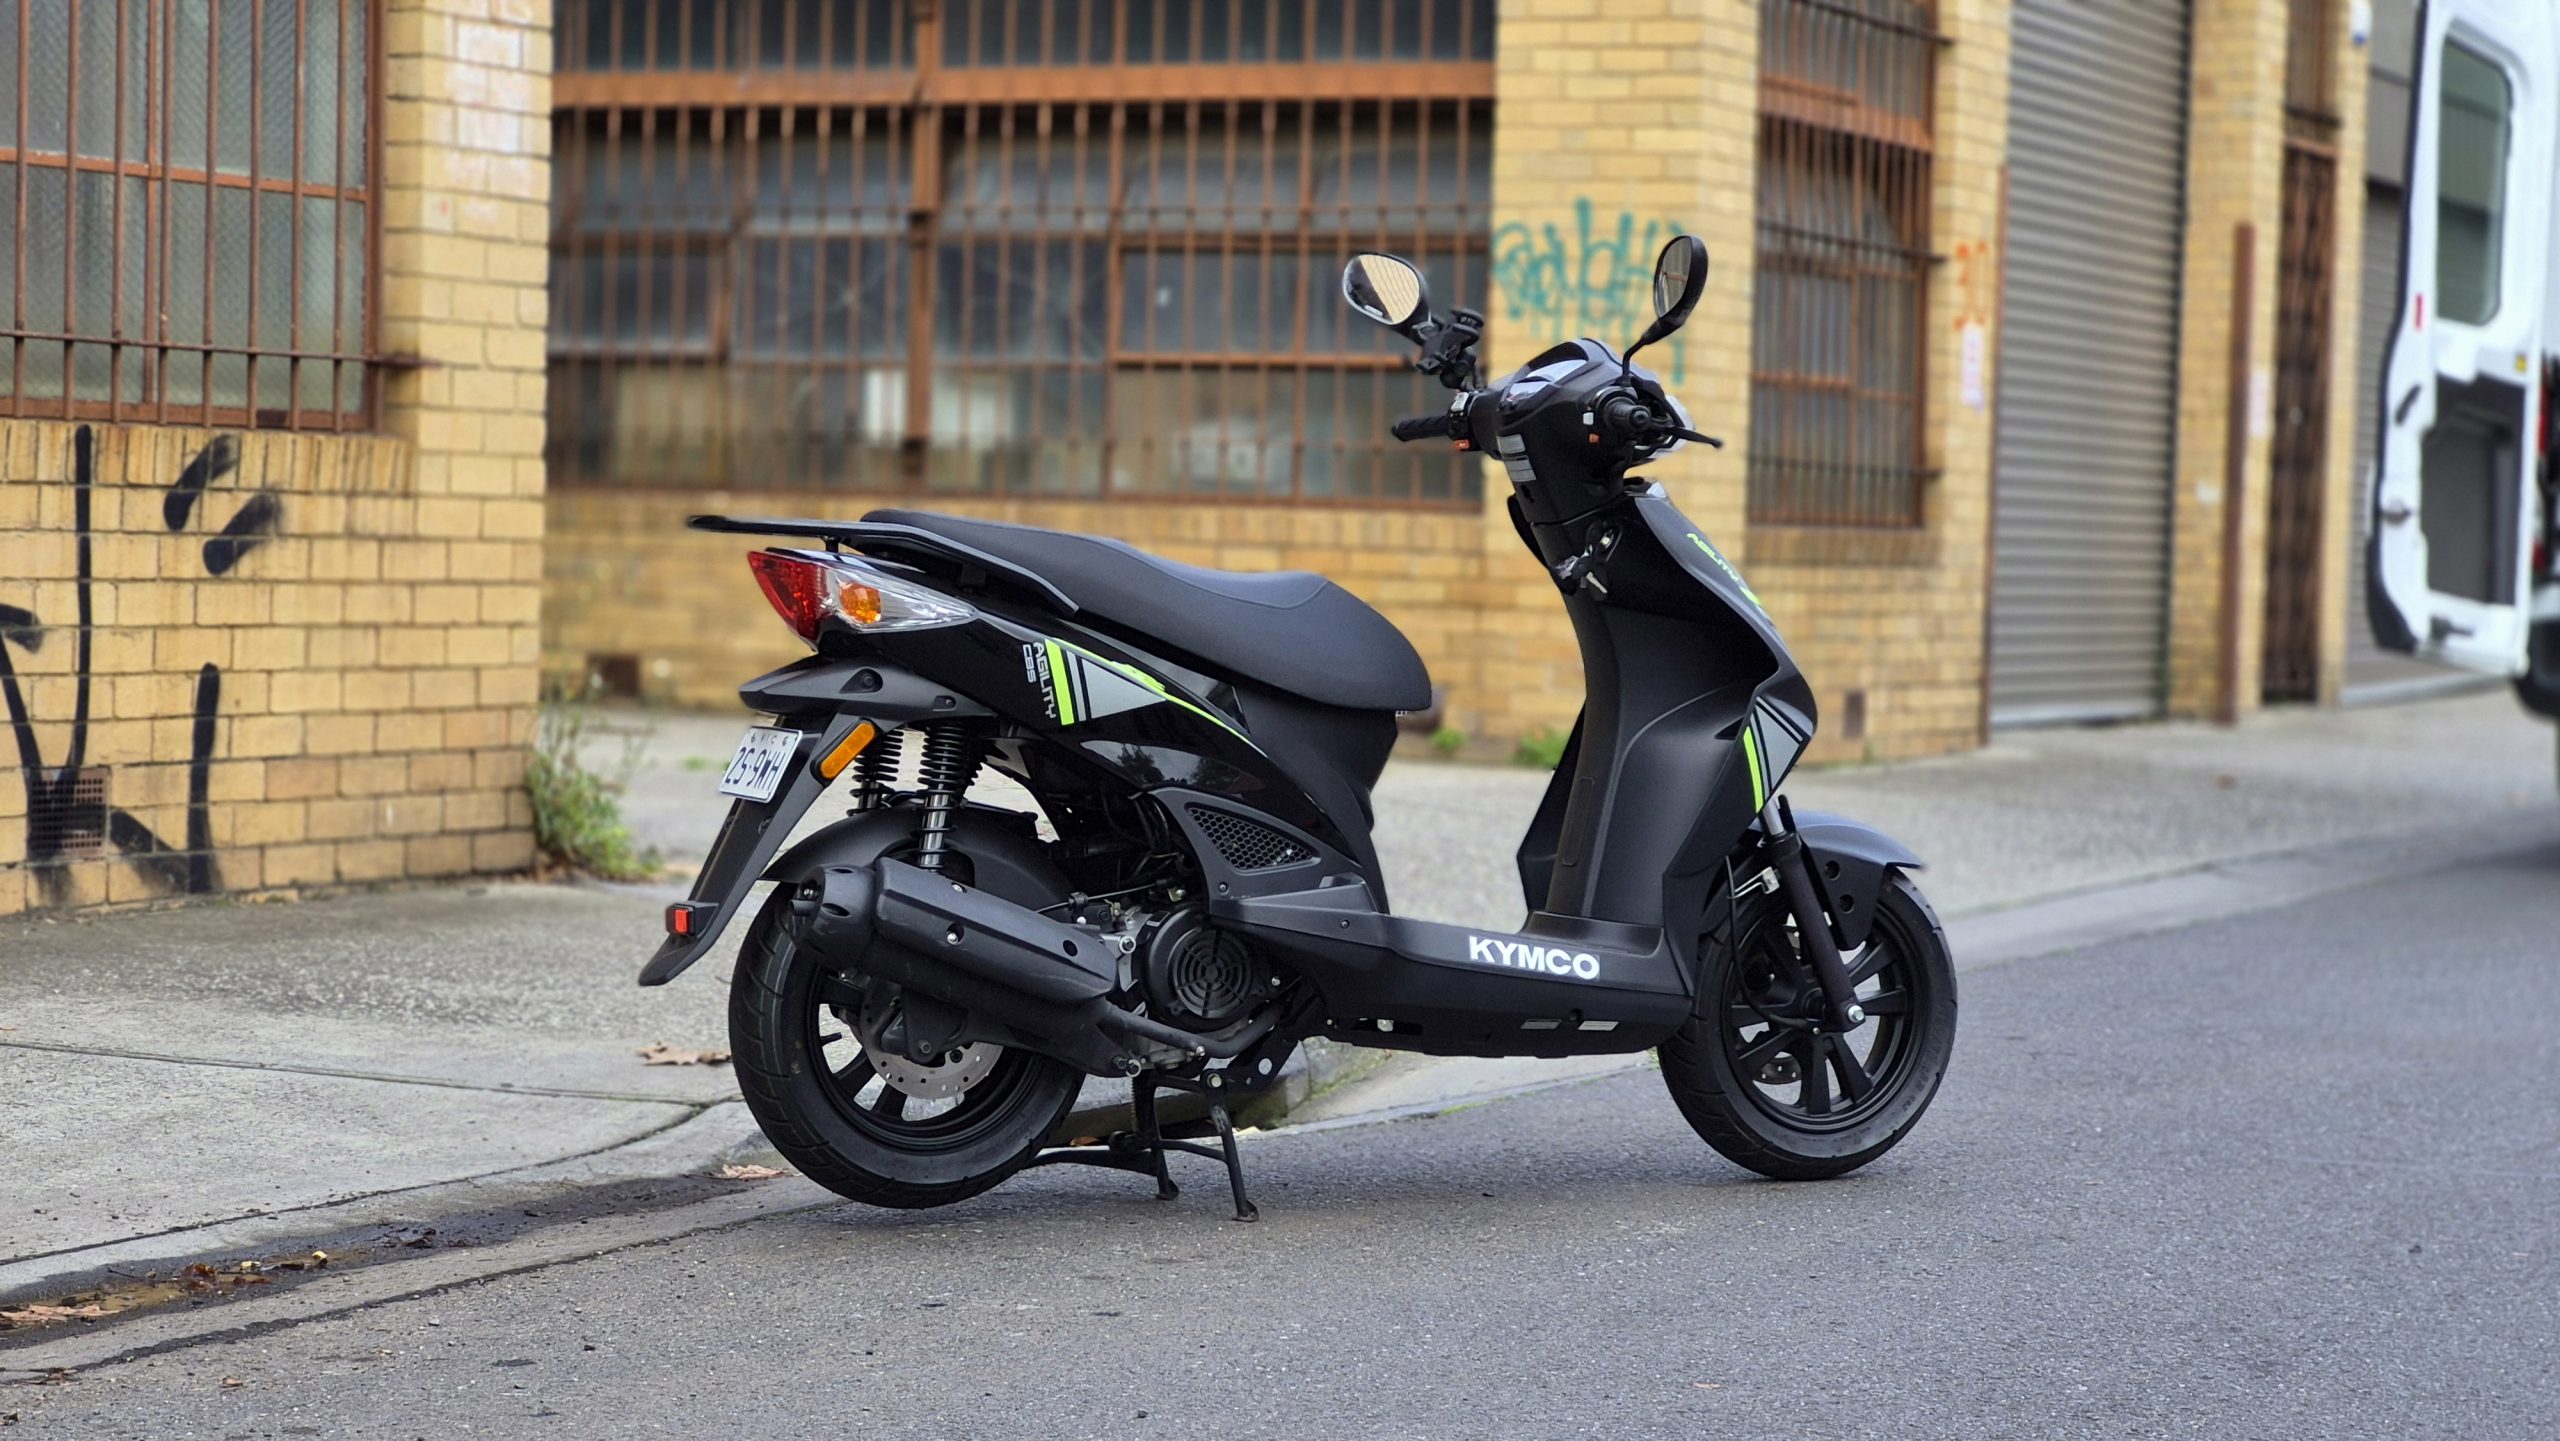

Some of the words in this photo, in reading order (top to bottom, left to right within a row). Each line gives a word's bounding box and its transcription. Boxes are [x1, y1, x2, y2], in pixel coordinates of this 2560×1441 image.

[1022, 644, 1037, 683] CBS
[1033, 641, 1057, 719] AGILITY
[1469, 935, 1600, 980] KYMCO
